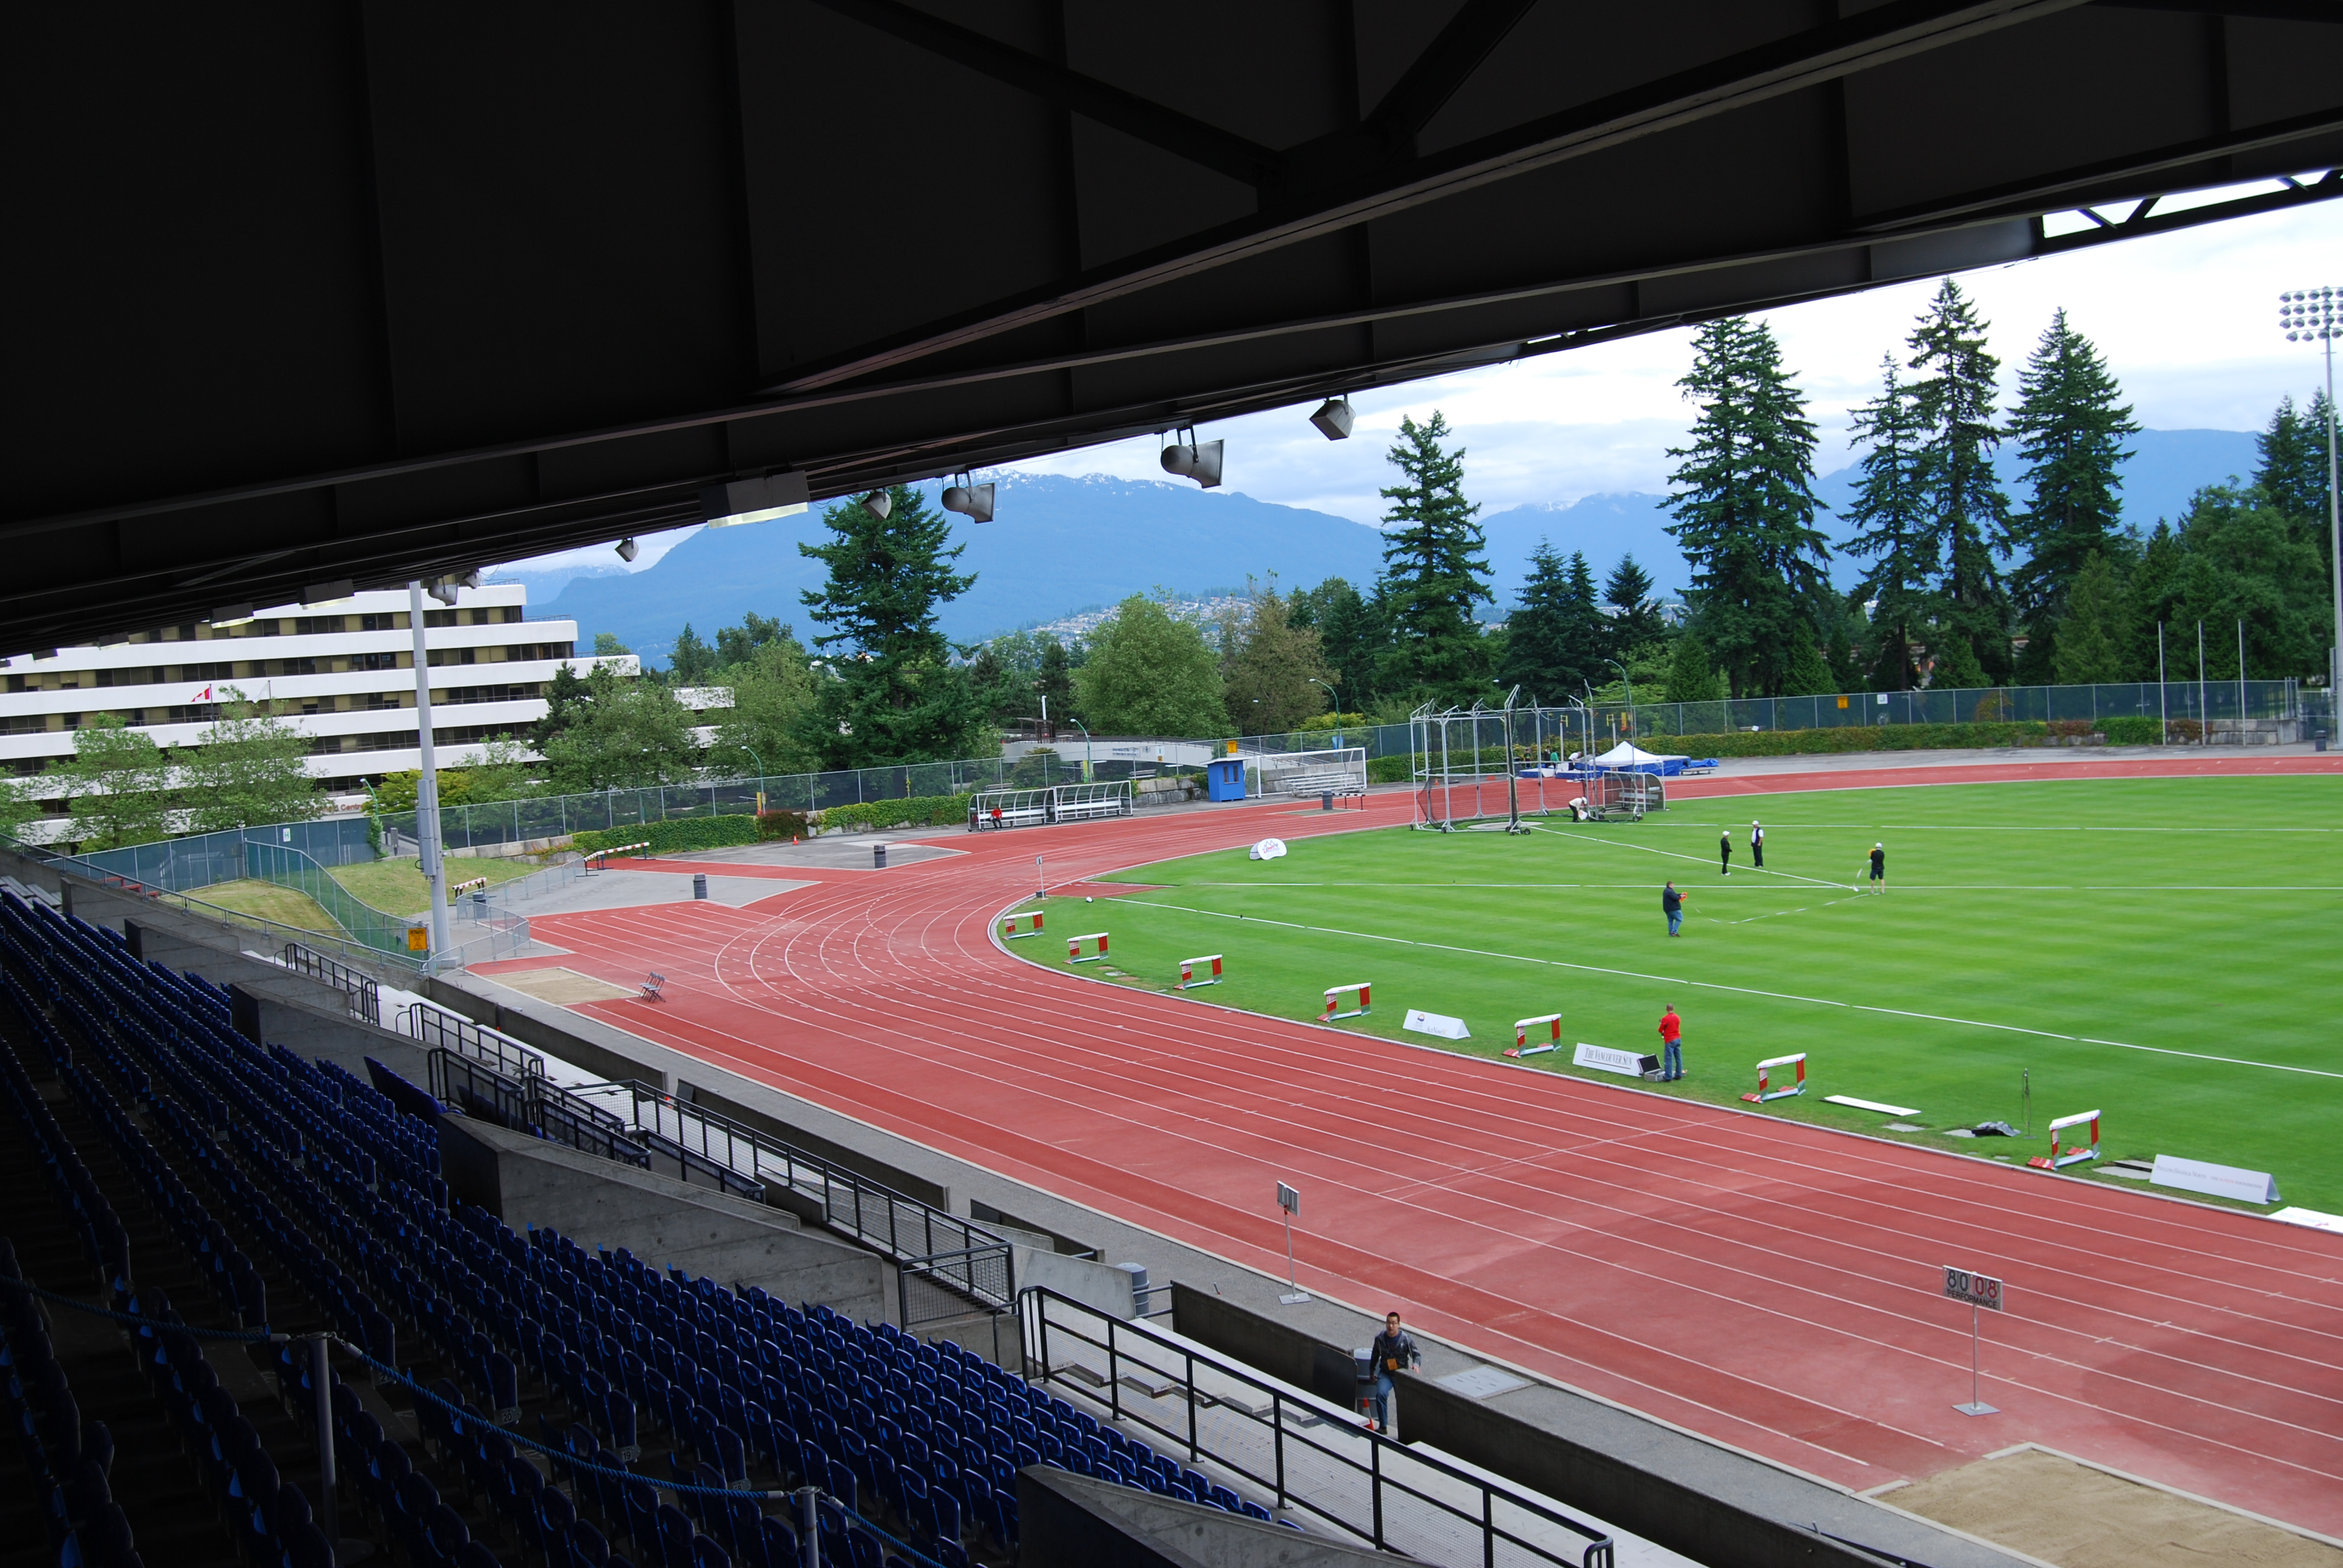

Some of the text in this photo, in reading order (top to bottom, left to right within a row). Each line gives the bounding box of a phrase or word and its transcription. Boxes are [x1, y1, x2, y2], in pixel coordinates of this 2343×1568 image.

[1947, 1269, 1997, 1299] 80 08
[1947, 1289, 1997, 1309] PERFORMANCE
[381, 1373, 390, 1382] 21
[503, 1413, 512, 1422] 20
[623, 1451, 631, 1460] 19
